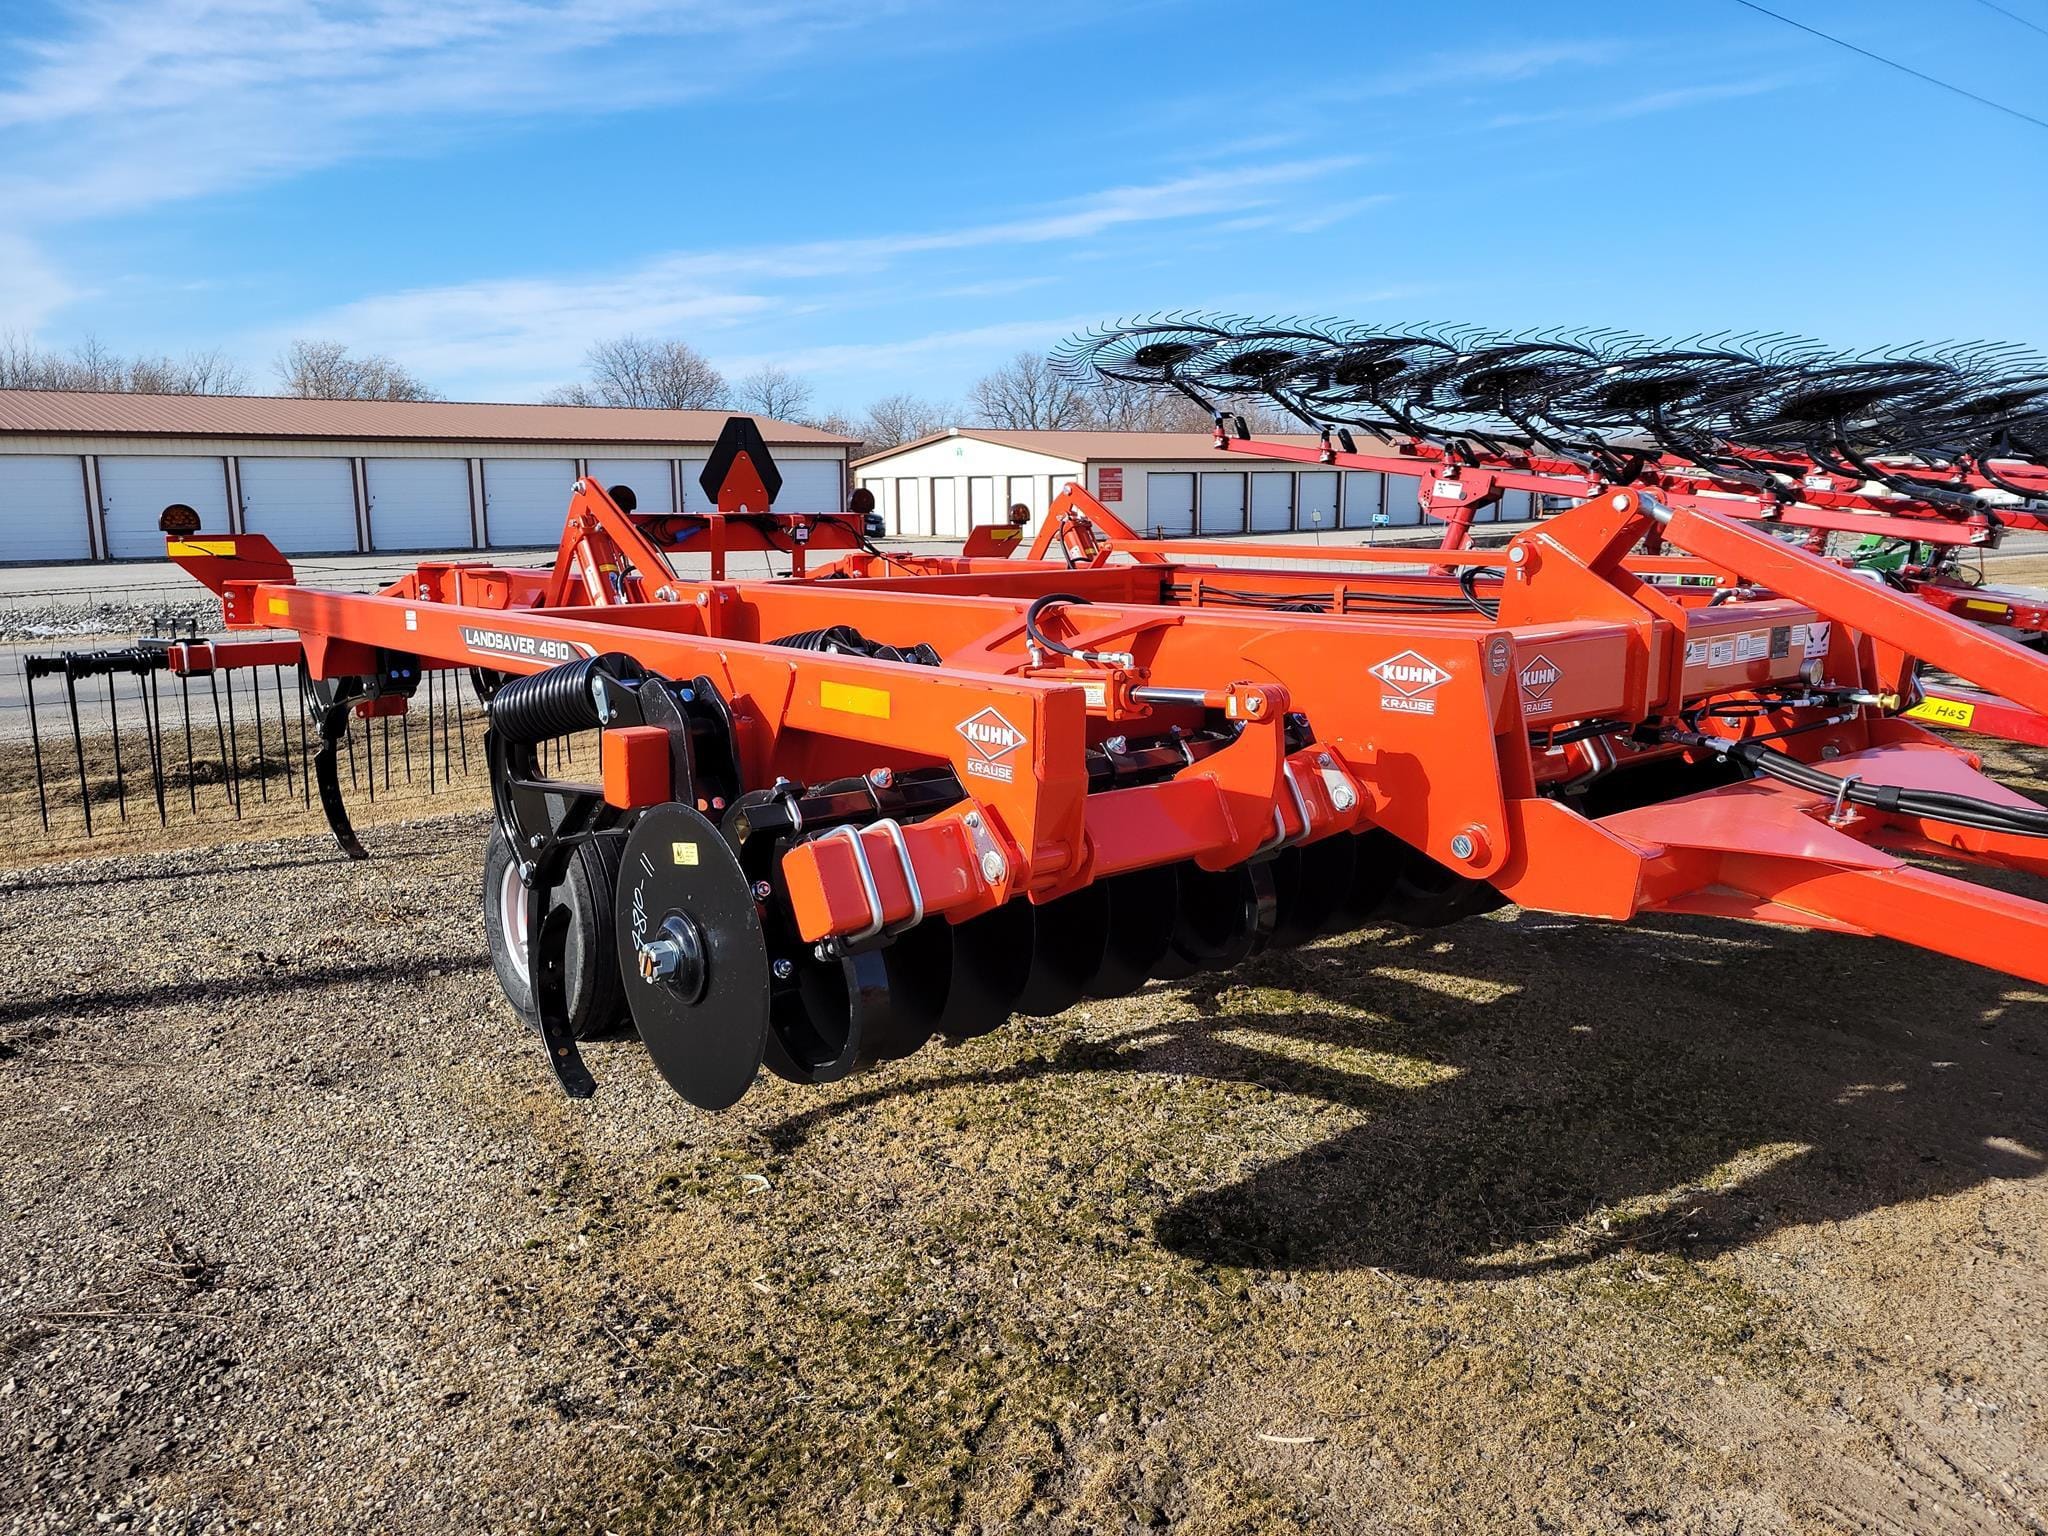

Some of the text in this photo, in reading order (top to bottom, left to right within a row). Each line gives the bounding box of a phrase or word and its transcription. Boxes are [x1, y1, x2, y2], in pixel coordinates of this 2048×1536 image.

[465, 629, 569, 660] LANDSAVER 4810
[1382, 665, 1437, 684] KUHN
[1522, 668, 1555, 686] KUHN
[1381, 698, 1435, 712] KRAUSE
[1935, 706, 1968, 720] H&S
[967, 722, 1014, 747] KUHN
[967, 760, 1013, 779] KRAUSE
